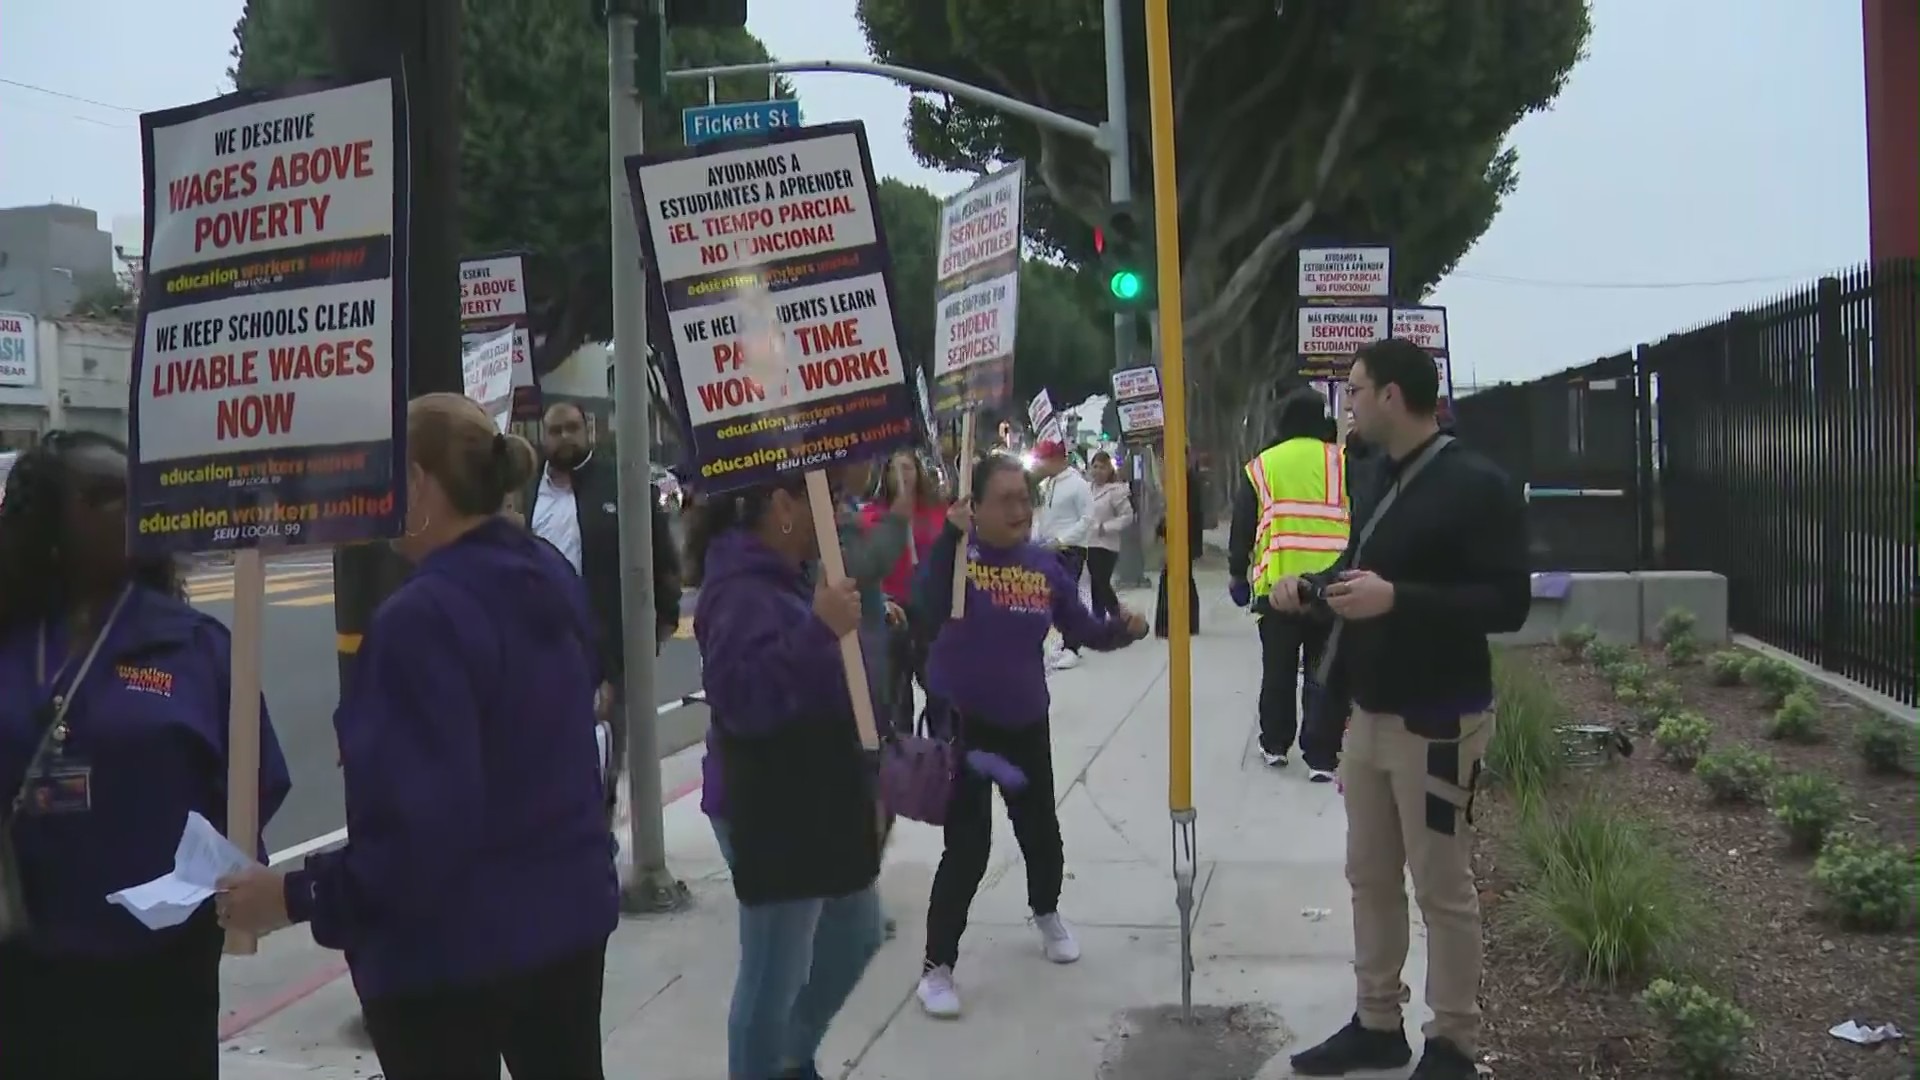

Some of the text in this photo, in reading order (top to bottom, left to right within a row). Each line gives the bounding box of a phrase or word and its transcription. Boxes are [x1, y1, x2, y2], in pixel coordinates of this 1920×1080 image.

[215, 113, 315, 156] WE DESERVE
[694, 109, 789, 136] Fickett St
[169, 139, 374, 214] WAGES ABOVE
[708, 153, 801, 187] AYUDAMOS A
[660, 168, 854, 220] ESTUDIANTES A APRENDER
[195, 194, 331, 253] POVERTY
[669, 195, 856, 244] ¡EL TIEMPO PARCIAL
[700, 223, 835, 266] NO UNCIONA!
[166, 268, 239, 293] education
[473, 279, 517, 297] ABOVE
[0, 320, 22, 333] RIA
[156, 299, 375, 353] WE KEEP SCHOOLS CLEAN
[684, 288, 877, 343] WE HE DENTS LEARN
[951, 308, 998, 342] STUDENT
[0, 337, 25, 362] SH
[794, 317, 862, 356] TIME
[1304, 341, 1359, 351] ESTUDIANT
[153, 339, 375, 397] LIVABLE WAGES
[799, 348, 890, 392] WORK!
[217, 392, 295, 440] NOW
[717, 415, 785, 439] education
[701, 418, 912, 478] education workers united
[776, 457, 800, 472] SEIU
[802, 452, 832, 468] LOCAL
[160, 462, 233, 486] education
[139, 489, 394, 533] education workers united
[213, 523, 300, 541] SEIU LOCAL 99
[967, 561, 1047, 588] ducation
